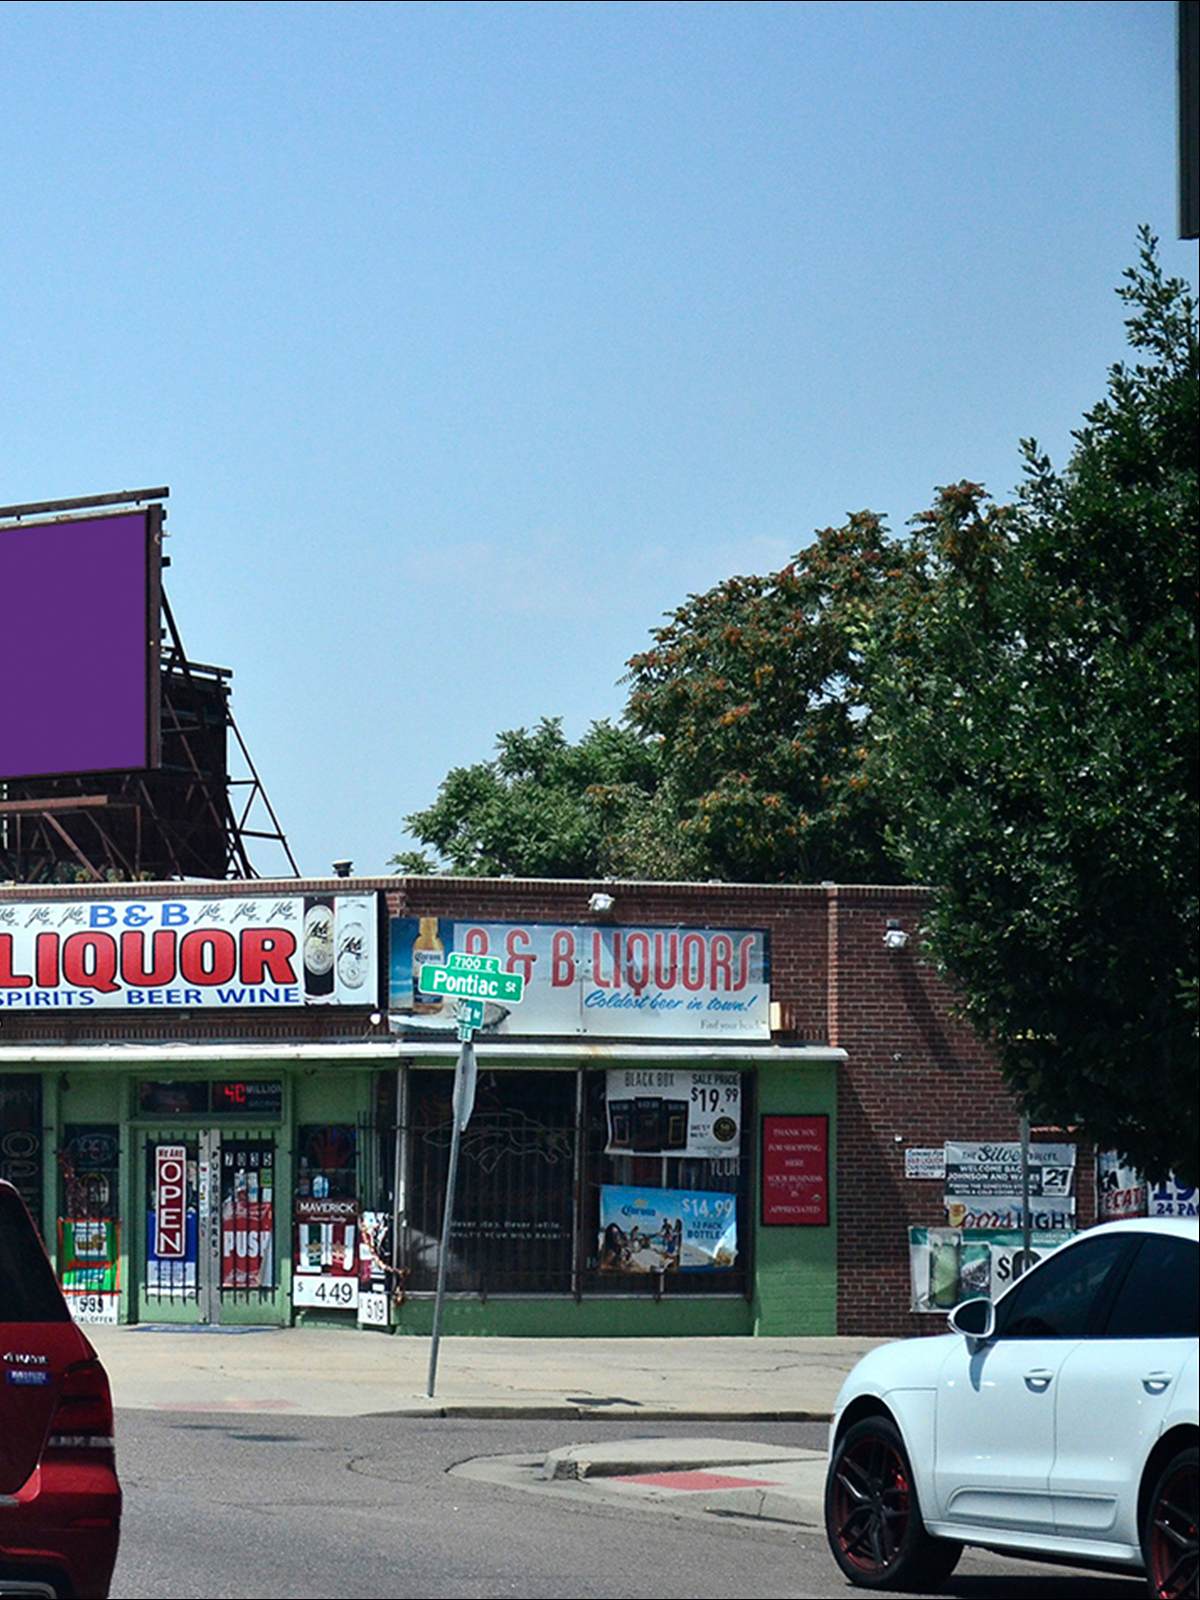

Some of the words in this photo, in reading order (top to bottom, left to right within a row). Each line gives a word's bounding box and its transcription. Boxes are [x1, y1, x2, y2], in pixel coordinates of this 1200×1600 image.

[455, 956, 481, 969] 7100
[486, 960, 494, 971] E
[552, 929, 577, 988] B
[593, 931, 756, 997] LIQUORS
[433, 970, 499, 996] Pontiac
[505, 981, 517, 993] St
[127, 989, 204, 1005] BEER
[217, 987, 300, 1003] WINE
[585, 990, 648, 1010] Coldest
[649, 993, 684, 1010] beer
[686, 999, 702, 1010] in
[706, 995, 758, 1012] town!
[625, 1072, 654, 1087] BLACK
[657, 1072, 675, 1088] BOX
[978, 1144, 1022, 1163] Silve
[948, 1172, 989, 1181] JOHNSON
[990, 1172, 1010, 1181] AND
[1011, 1173, 1041, 1182] WAES
[1004, 1165, 1022, 1173] BAC
[1044, 1169, 1068, 1187] 21
[160, 1162, 183, 1253] OPEN
[300, 1202, 355, 1214] MAVERICK
[621, 1203, 657, 1217] Corona
[681, 1197, 734, 1219] $14.99
[1157, 1202, 1174, 1215] 24
[960, 1211, 1015, 1229] oors
[223, 1230, 271, 1258] PUSH
